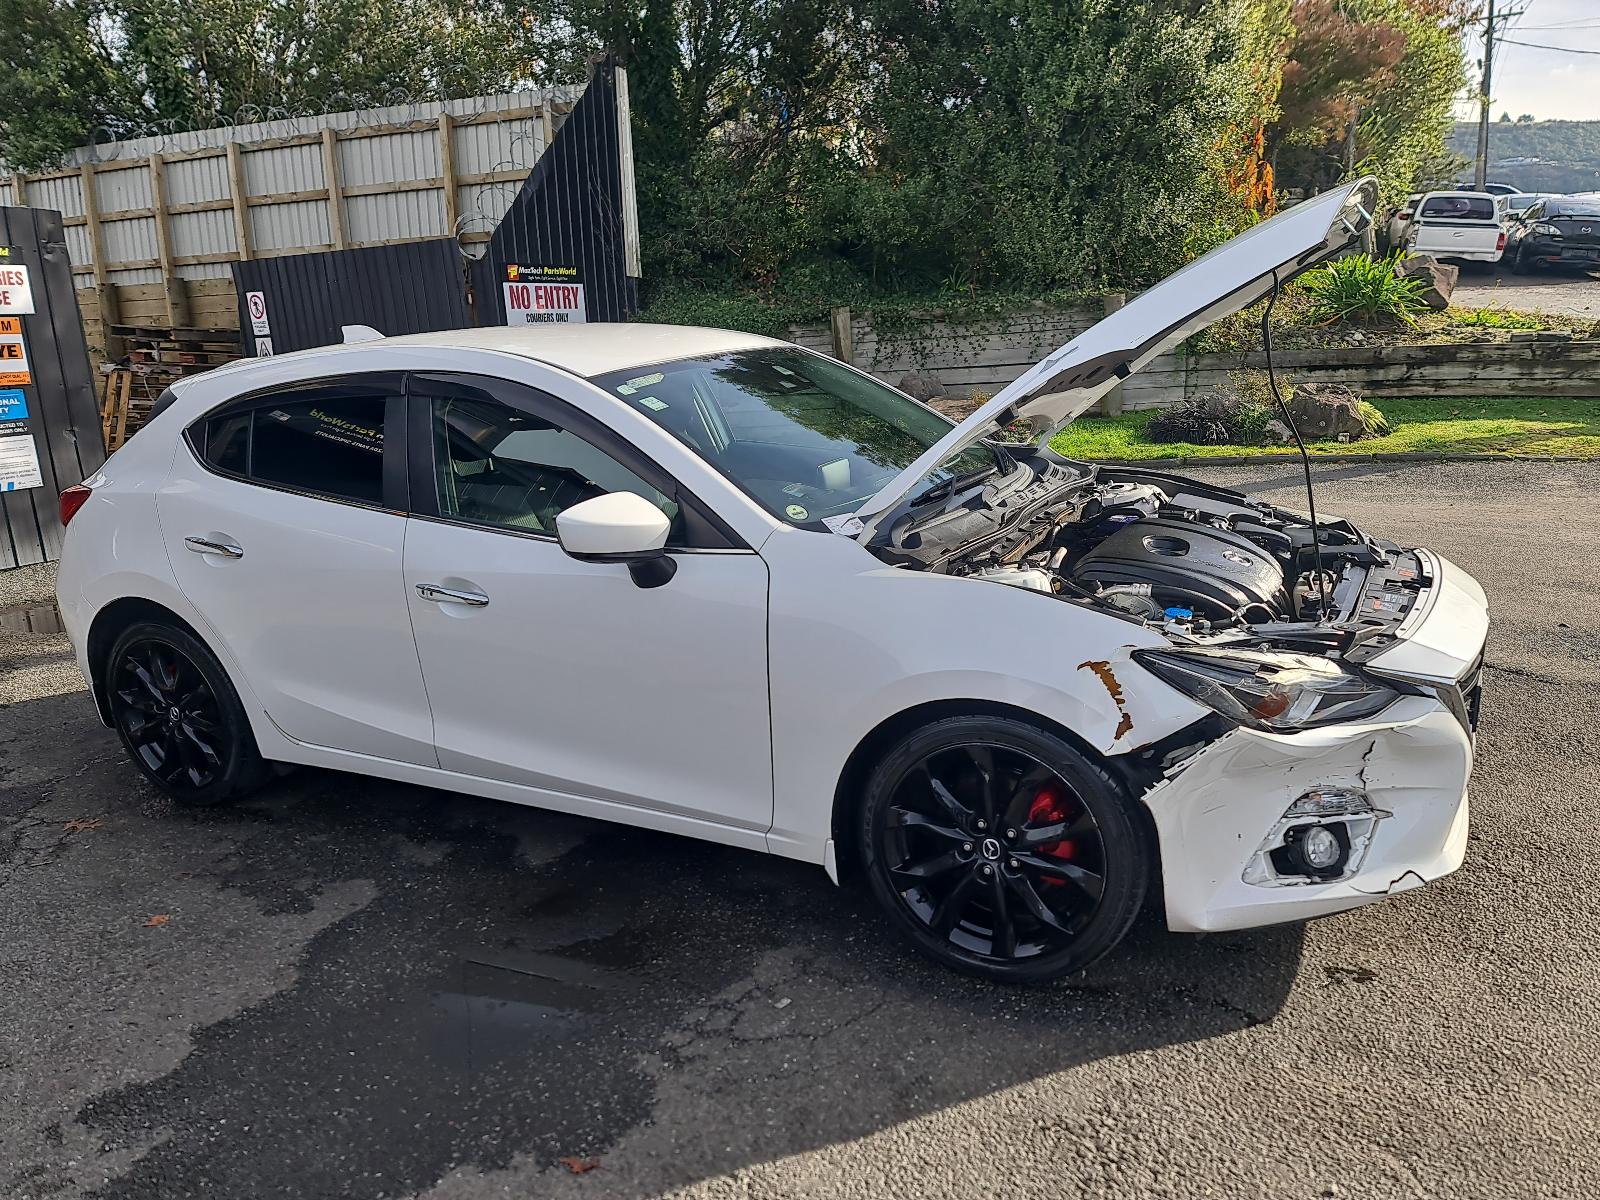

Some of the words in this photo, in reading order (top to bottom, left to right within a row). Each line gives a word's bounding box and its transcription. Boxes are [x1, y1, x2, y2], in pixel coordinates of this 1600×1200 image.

[543, 266, 577, 276] PartsWorld
[0, 271, 24, 286] IES
[509, 285, 531, 310] NO
[535, 285, 579, 310] ENTRY
[526, 313, 554, 323] COURIERS
[555, 313, 569, 323] ONLY
